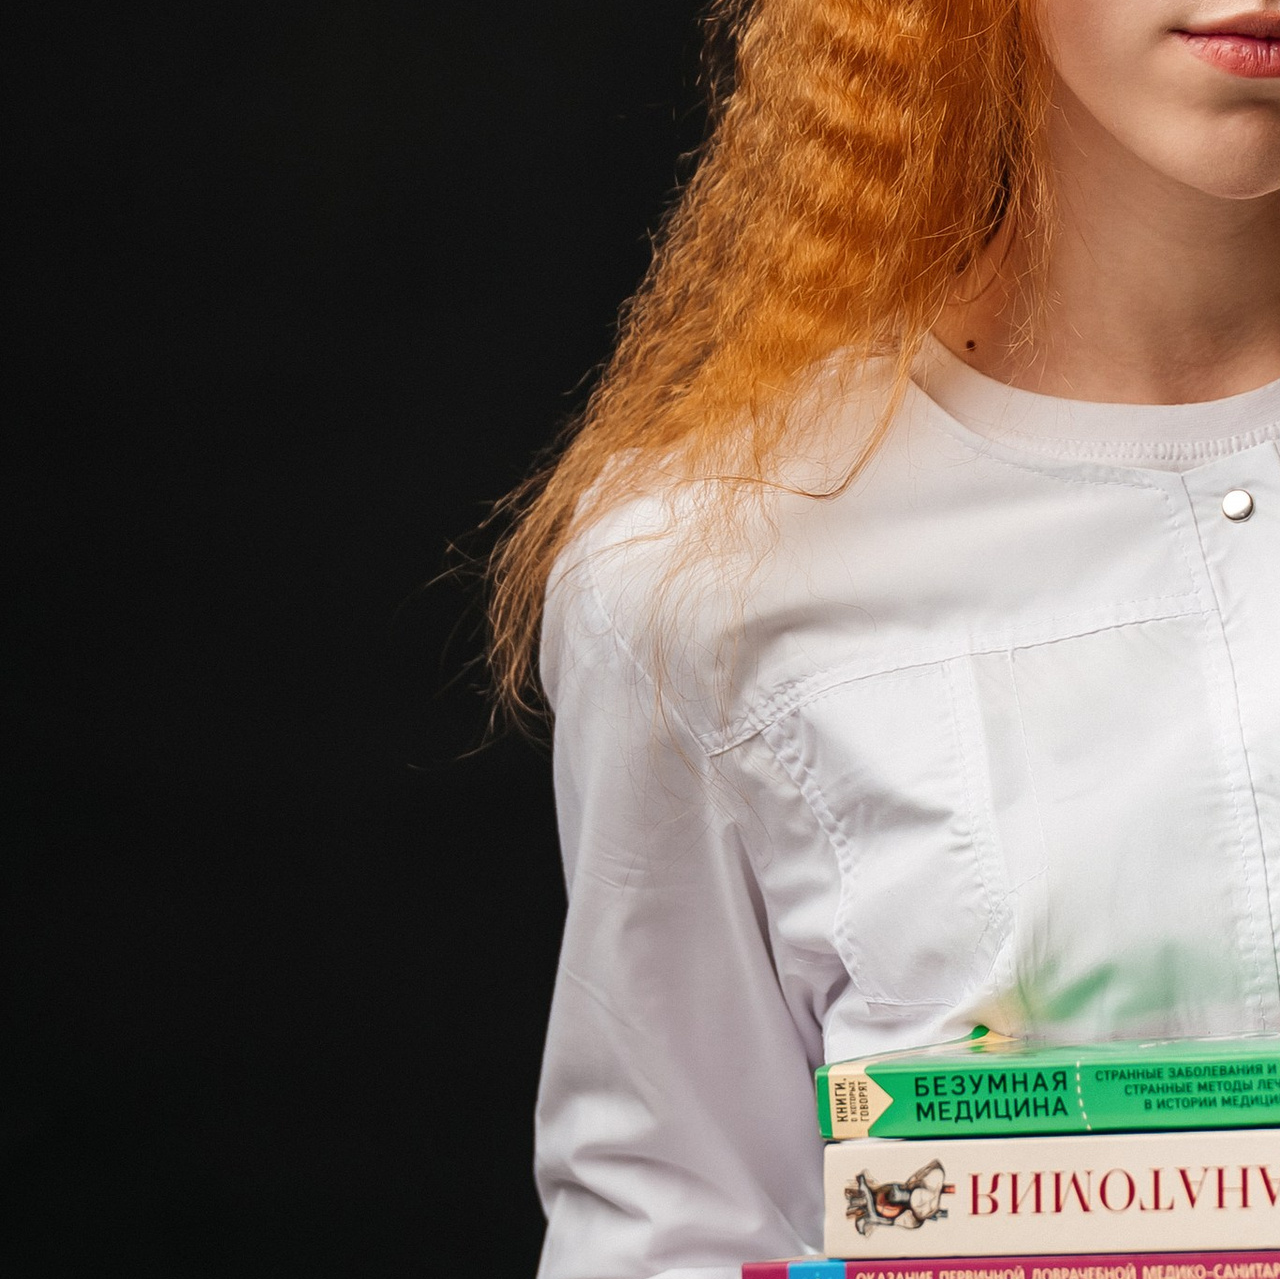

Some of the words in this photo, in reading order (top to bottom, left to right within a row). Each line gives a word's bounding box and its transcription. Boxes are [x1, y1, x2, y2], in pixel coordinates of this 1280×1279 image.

[914, 1071, 1068, 1097] БЕЗУМНАЯ
[1095, 1067, 1164, 1082] СТРАННЫЕ
[1168, 1063, 1264, 1079] ЗАБОЛЕВАНИЯ
[1268, 1063, 1276, 1073] И
[848, 1081, 857, 1115] КОТОРЫХ
[1125, 1081, 1193, 1096] СТРАННЫЕ
[1197, 1079, 1253, 1094] МЕТОДЫ
[858, 1081, 870, 1122] ГОВОРЯТ
[916, 1097, 1069, 1123] МЕДИЦИНА
[1144, 1099, 1152, 1110] В
[1156, 1096, 1217, 1110] ИСТОРИИ
